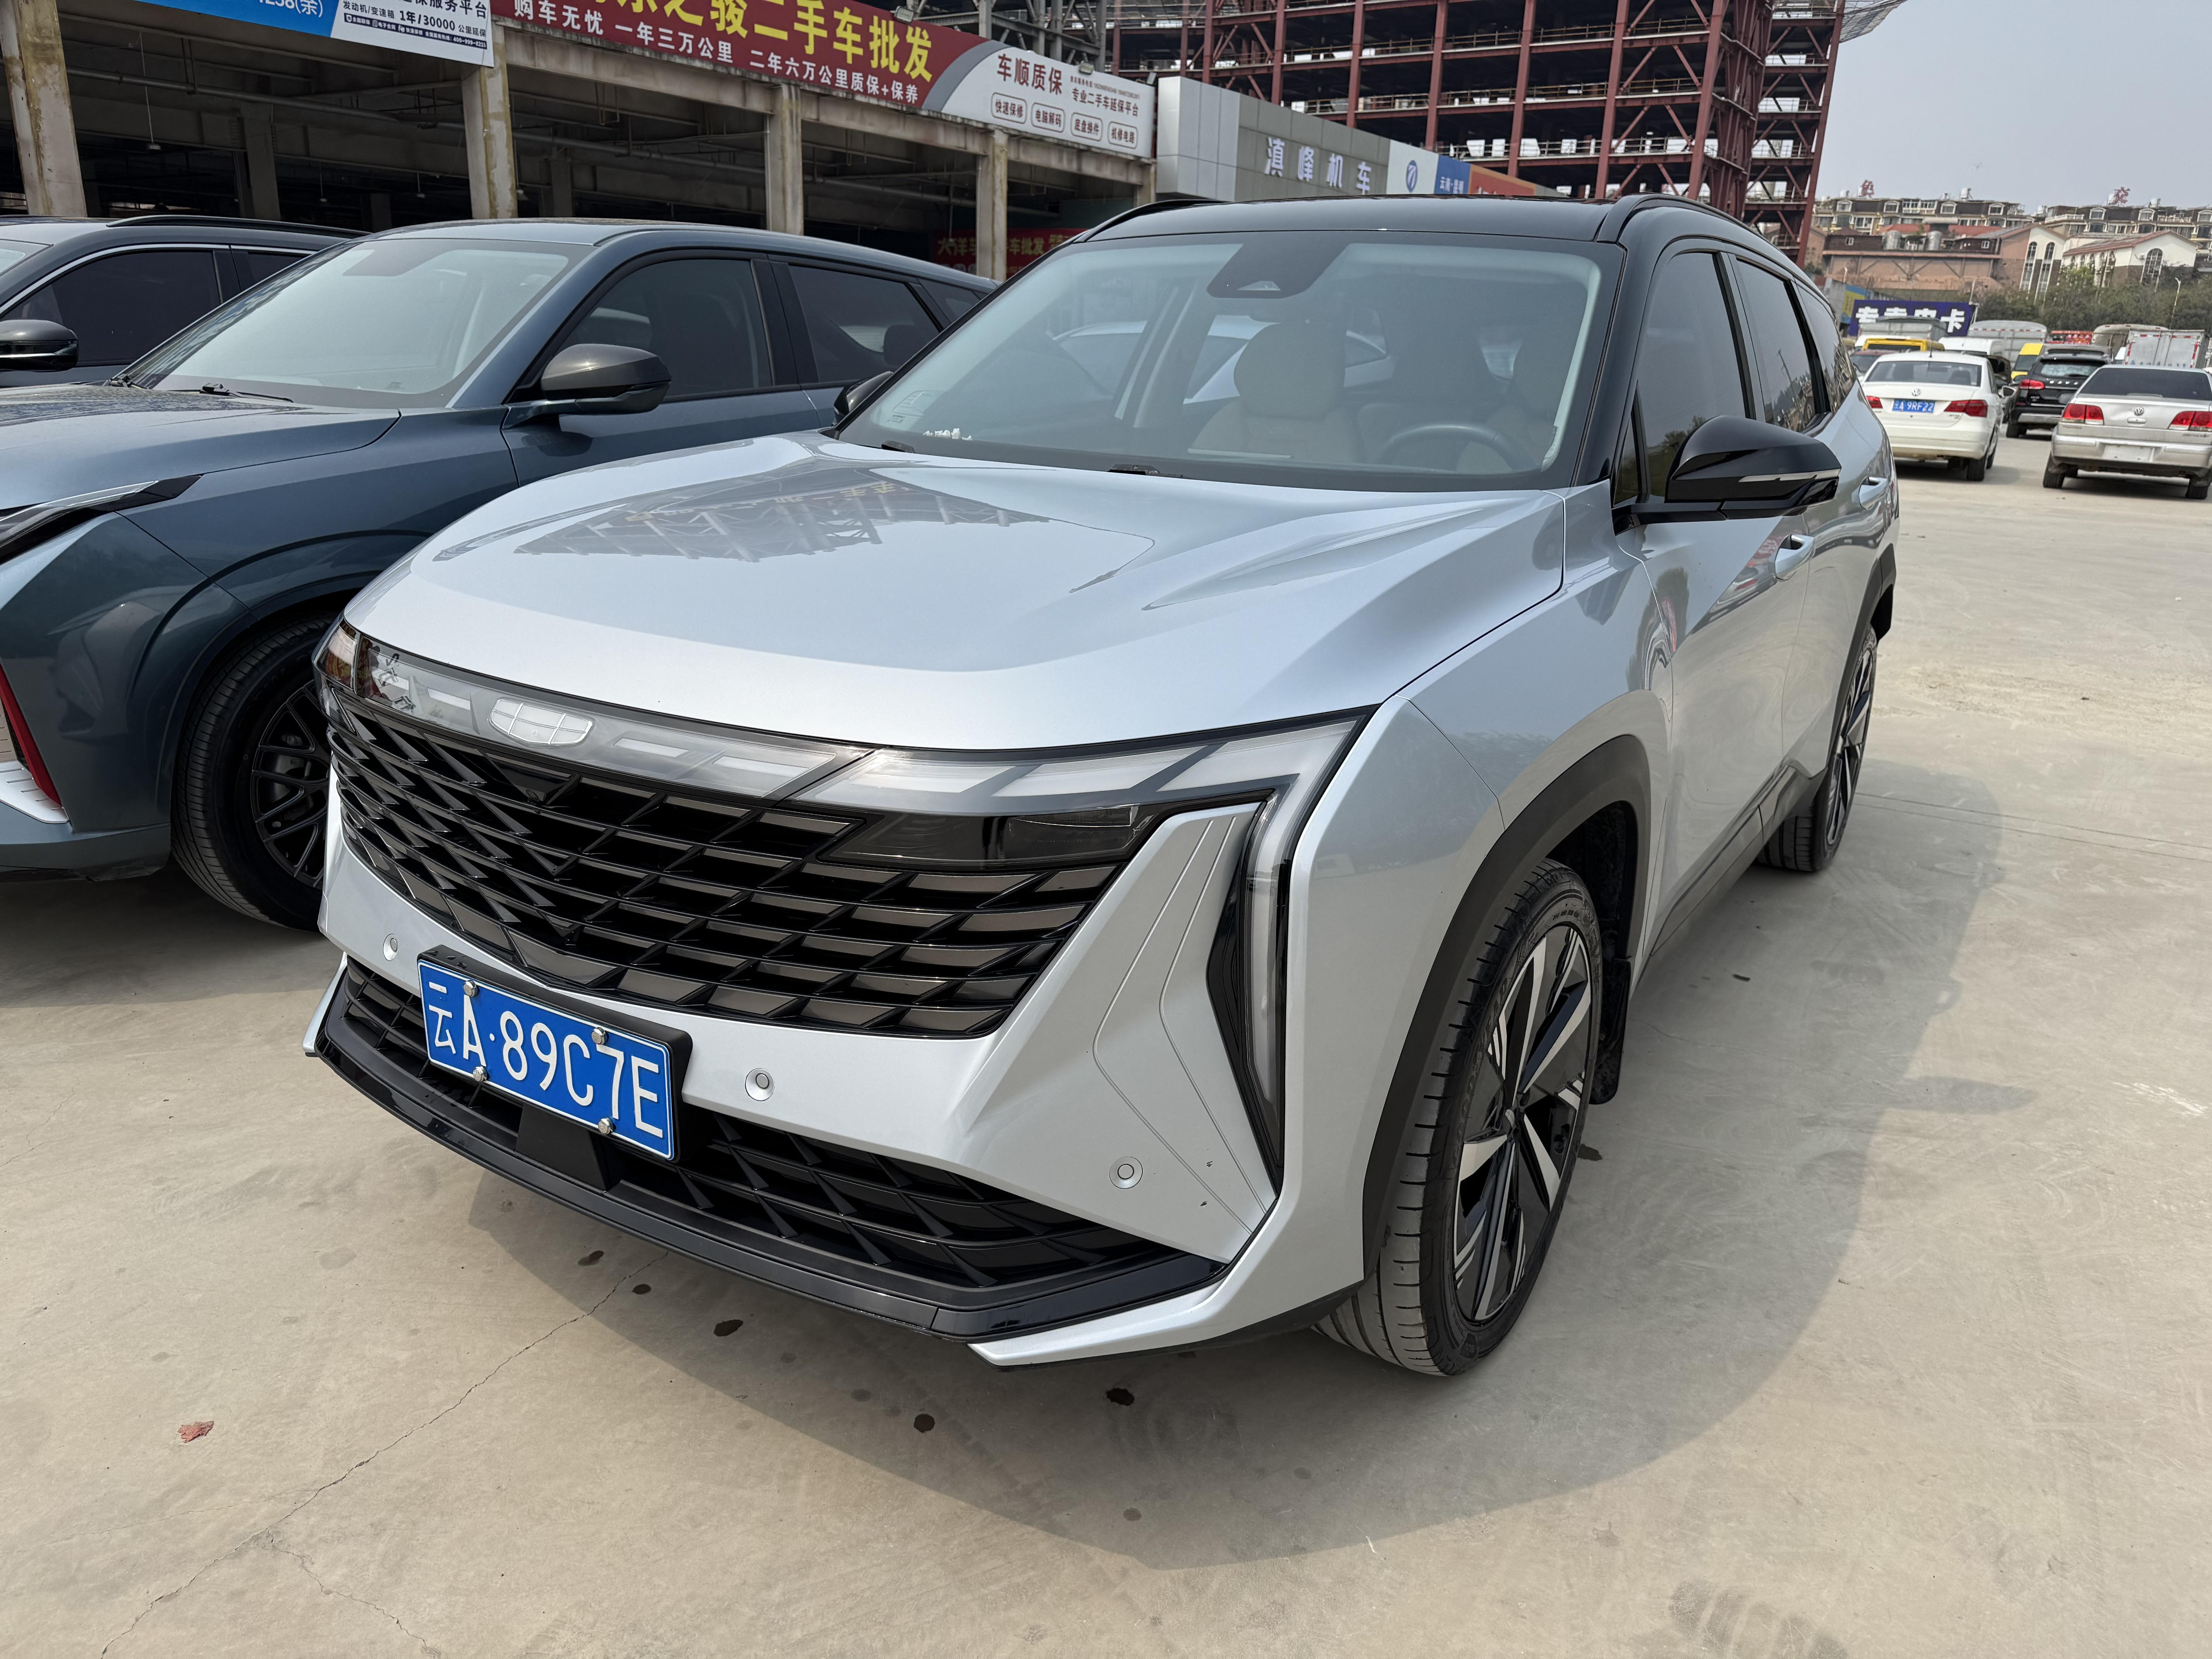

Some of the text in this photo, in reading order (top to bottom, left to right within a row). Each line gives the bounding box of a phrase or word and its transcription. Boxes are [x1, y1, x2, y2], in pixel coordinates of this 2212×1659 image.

[343, 1, 487, 38] 发动机/变速箱 1年/30000 公里延保
[399, 0, 487, 19] 服务平台
[515, 0, 918, 104] 购车无忧 一年三万公里 二年六万公里质保+保养
[997, 53, 1062, 95] 车顺质保
[1071, 88, 1139, 117] 专业二手车延保平台
[1264, 137, 1372, 195] 滇峰机车
[428, 981, 663, 1139] 云A·89C7E
